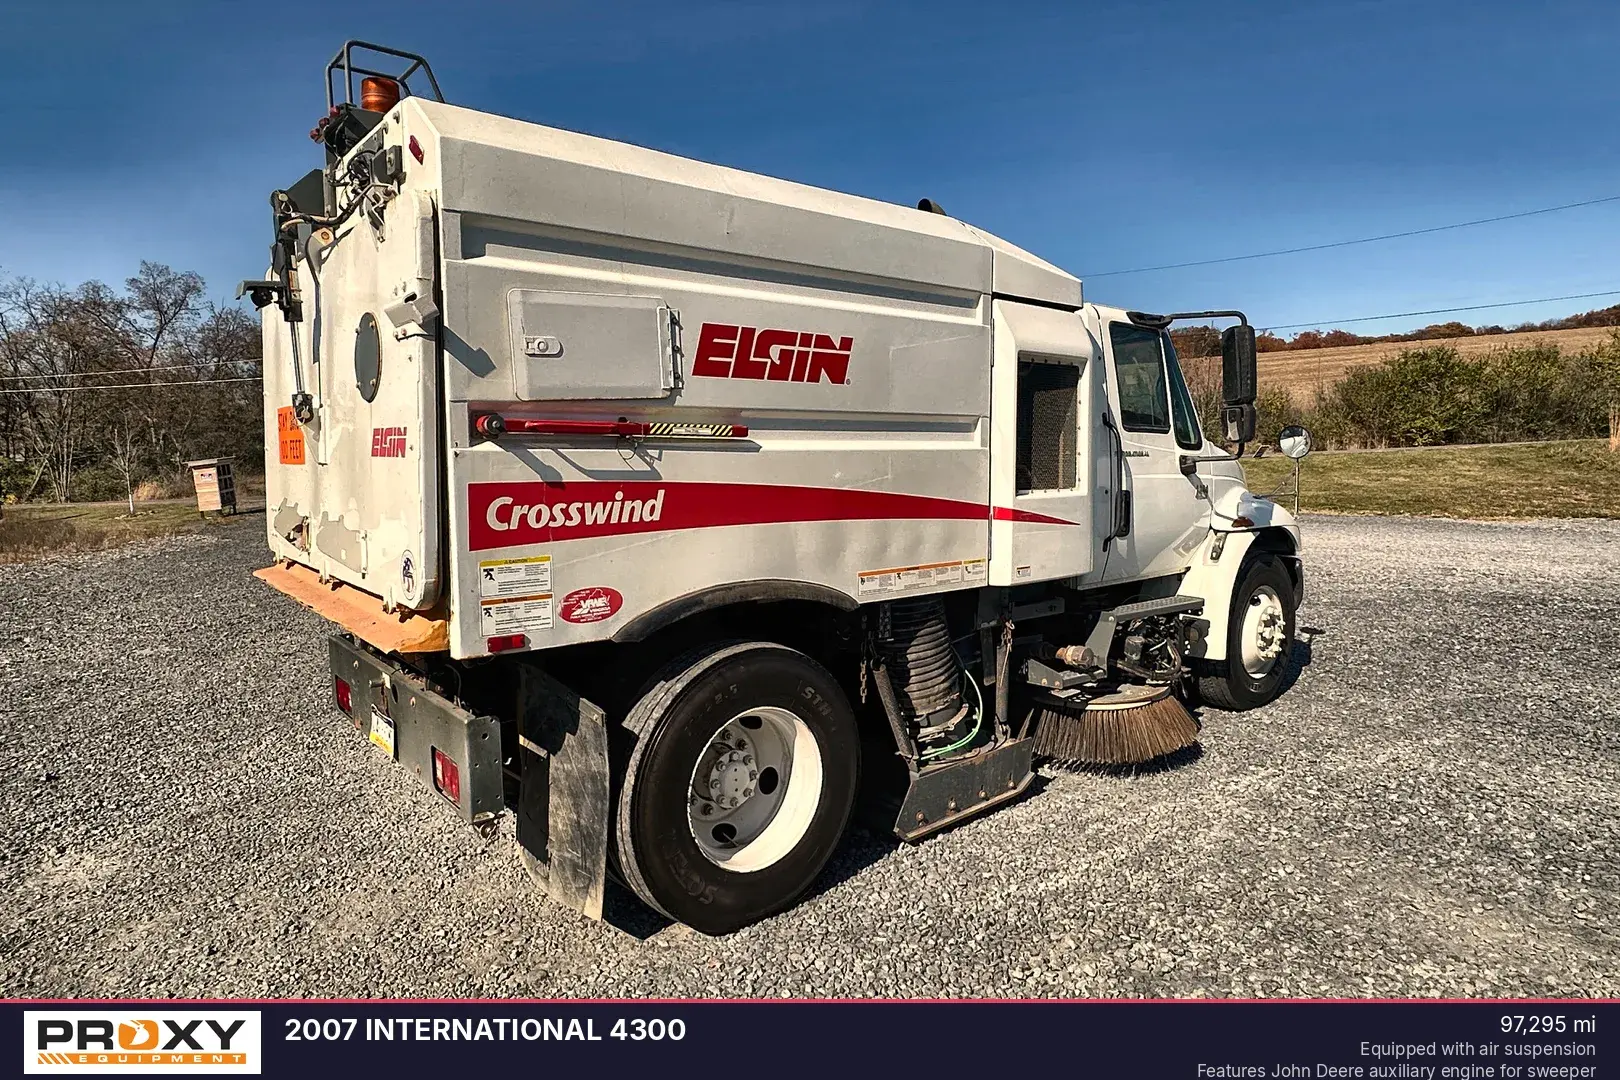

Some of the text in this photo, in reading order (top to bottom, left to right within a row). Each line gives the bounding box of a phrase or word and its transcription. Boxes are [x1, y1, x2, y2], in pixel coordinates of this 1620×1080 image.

[691, 322, 854, 385] ELGIN
[371, 426, 407, 458] ELGIN
[486, 489, 666, 531] Crosswind
